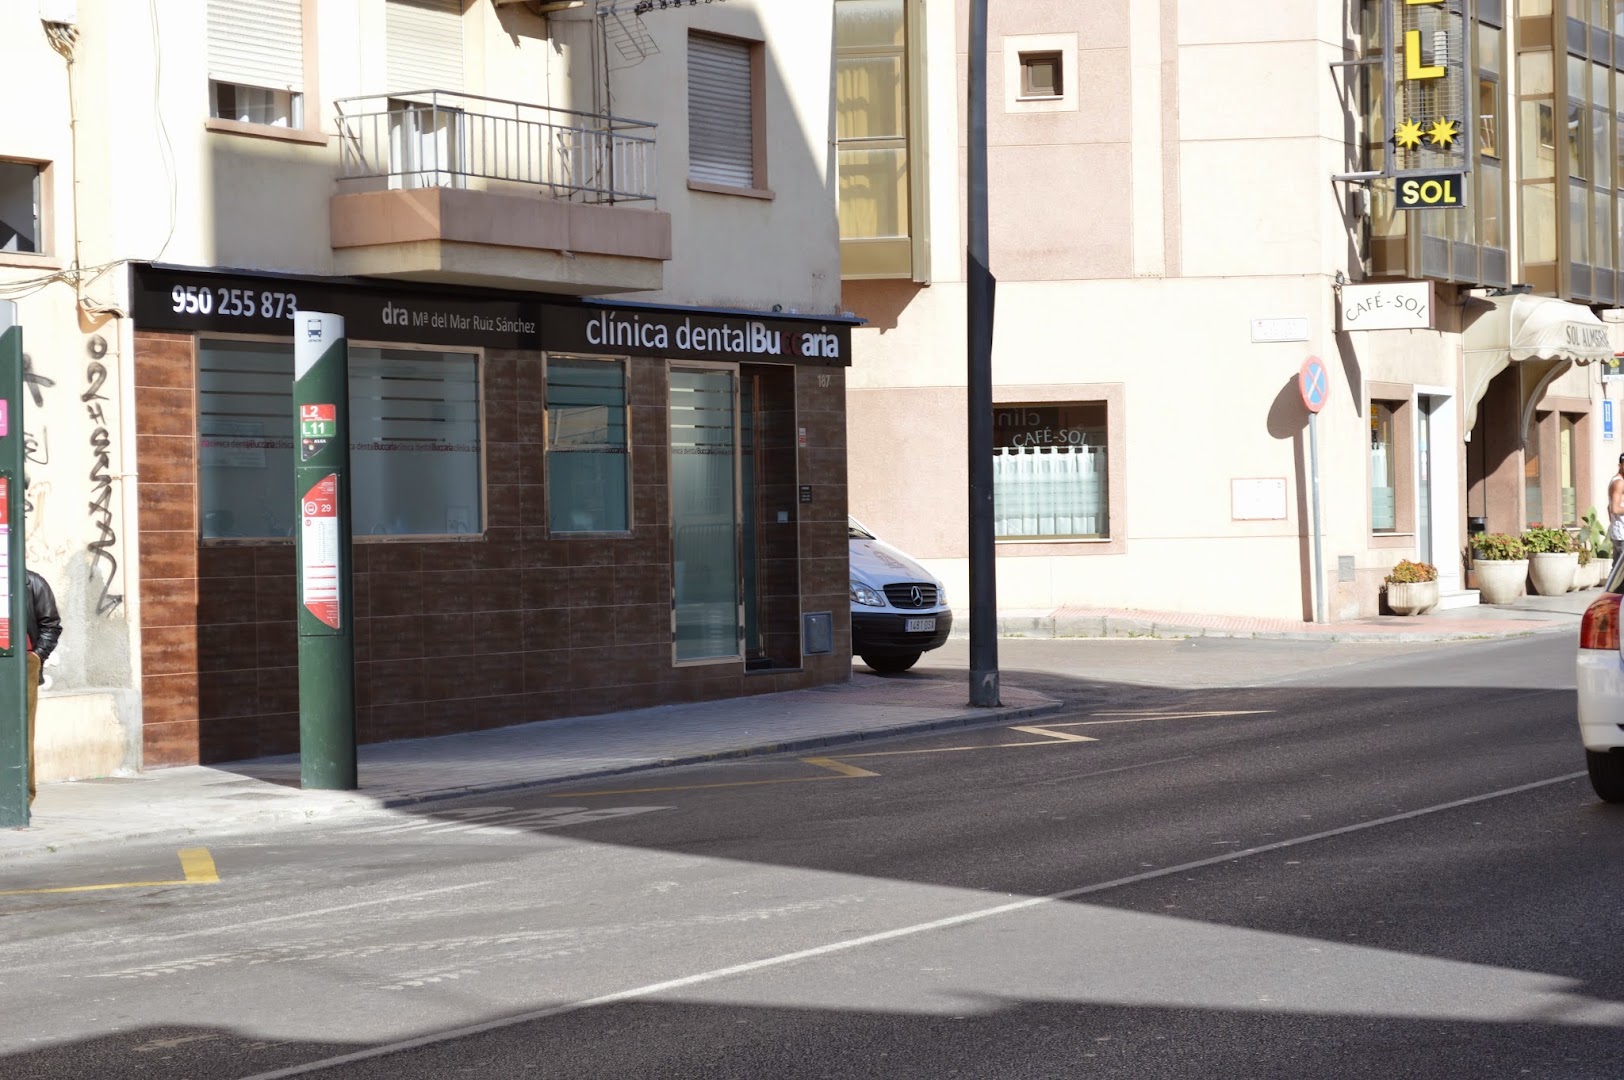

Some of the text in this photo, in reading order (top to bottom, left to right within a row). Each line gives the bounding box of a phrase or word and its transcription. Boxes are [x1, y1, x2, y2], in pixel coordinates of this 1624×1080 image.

[1406, 0, 1446, 80] L
[1402, 179, 1457, 205] SOL
[171, 284, 297, 320] 950 255 873
[382, 301, 409, 326] dra
[431, 313, 447, 328] del
[449, 314, 471, 330] Mar
[473, 315, 494, 331] Ruiz
[496, 316, 536, 334] Sánchez
[585, 310, 669, 349] clínica
[1566, 325, 1580, 346] SOL
[817, 374, 831, 388] 187
[302, 405, 319, 418] L2
[302, 422, 325, 435] L11
[321, 504, 332, 513] 29
